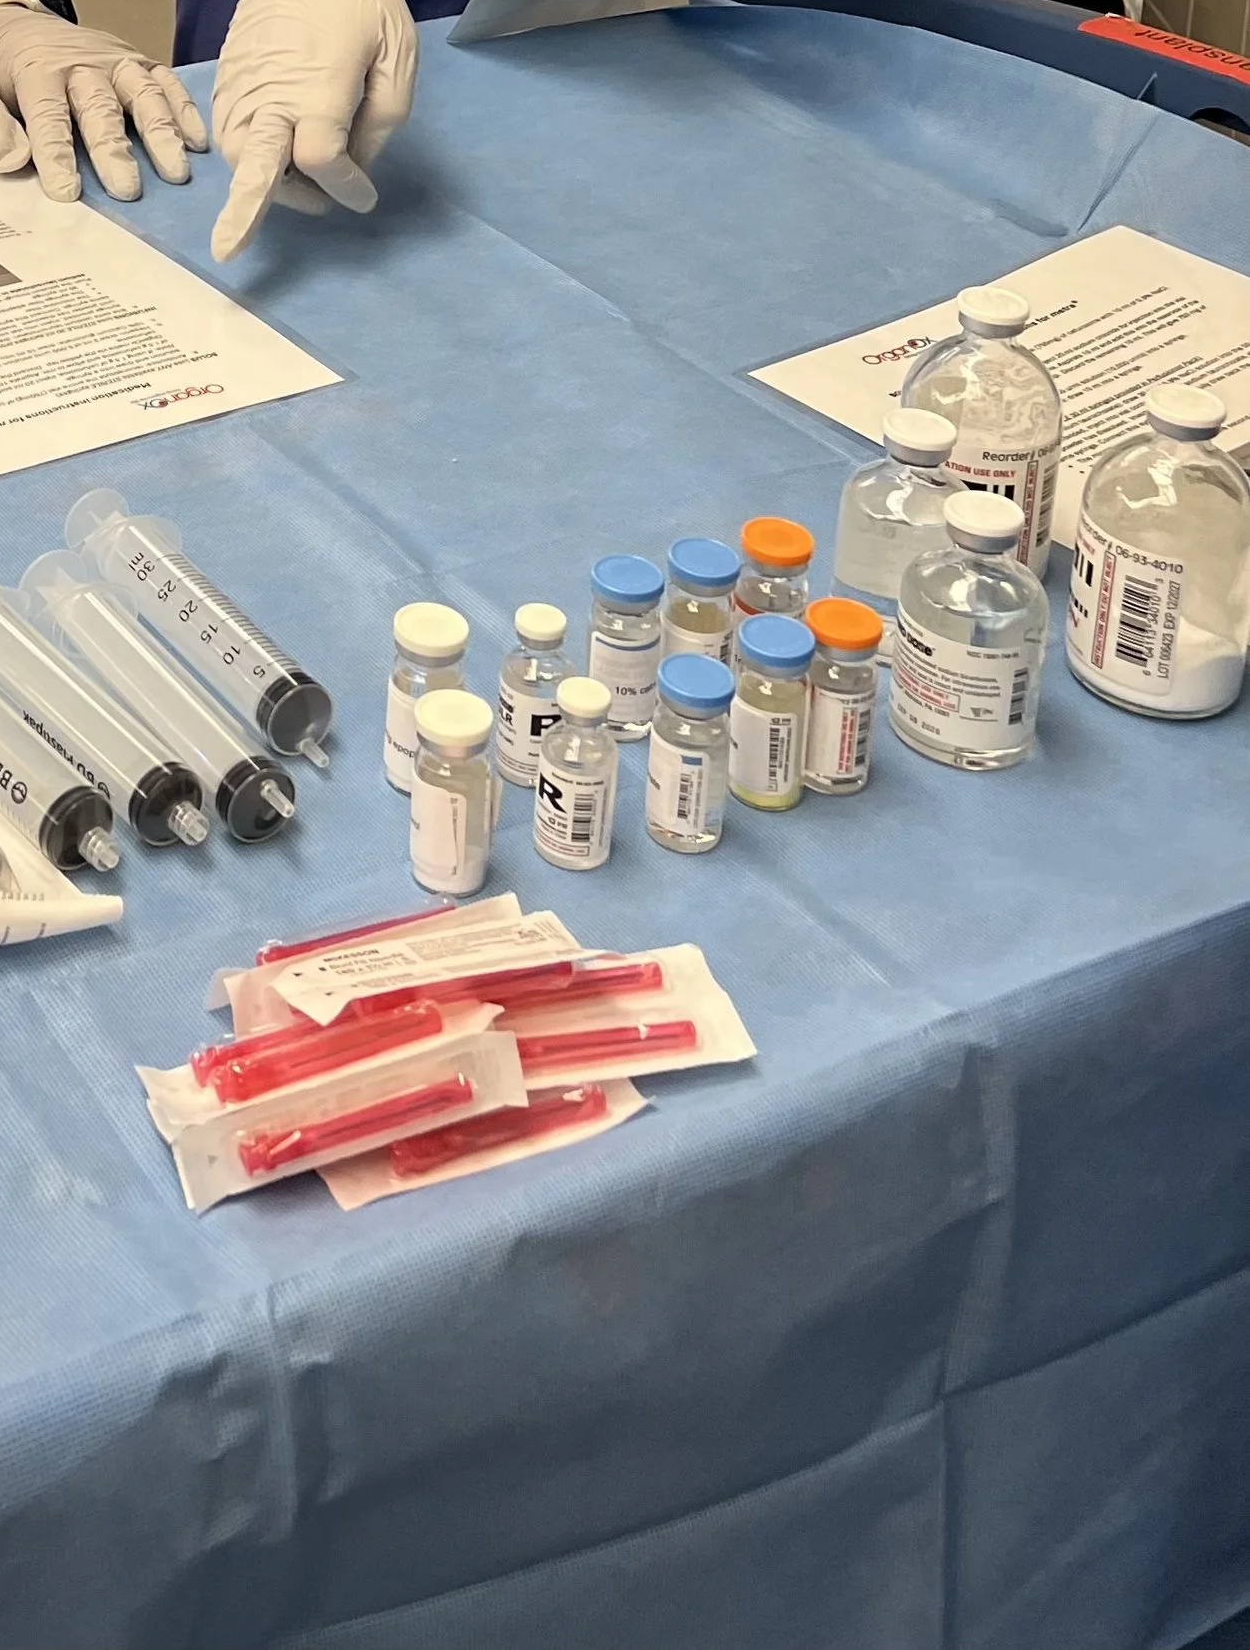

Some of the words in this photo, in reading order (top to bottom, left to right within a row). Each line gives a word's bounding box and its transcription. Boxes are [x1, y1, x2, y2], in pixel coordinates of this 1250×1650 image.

[861, 336, 938, 365] OrganOx
[982, 451, 1029, 462] Reorder
[973, 468, 991, 477] USE
[992, 470, 1017, 478] ONLY
[128, 552, 145, 572] ml
[1115, 544, 1184, 575] 06-93-4010
[136, 560, 155, 582] 30
[157, 579, 177, 602] 25
[1168, 580, 1181, 611] 12/2027
[178, 600, 198, 623] 20
[1163, 613, 1176, 630] EXP
[200, 623, 219, 644] 15
[222, 645, 241, 665] 10
[1092, 626, 1106, 669] INSTRUCTION
[252, 665, 266, 678] 5
[1158, 661, 1170, 679] LOT
[615, 685, 637, 696] 10%
